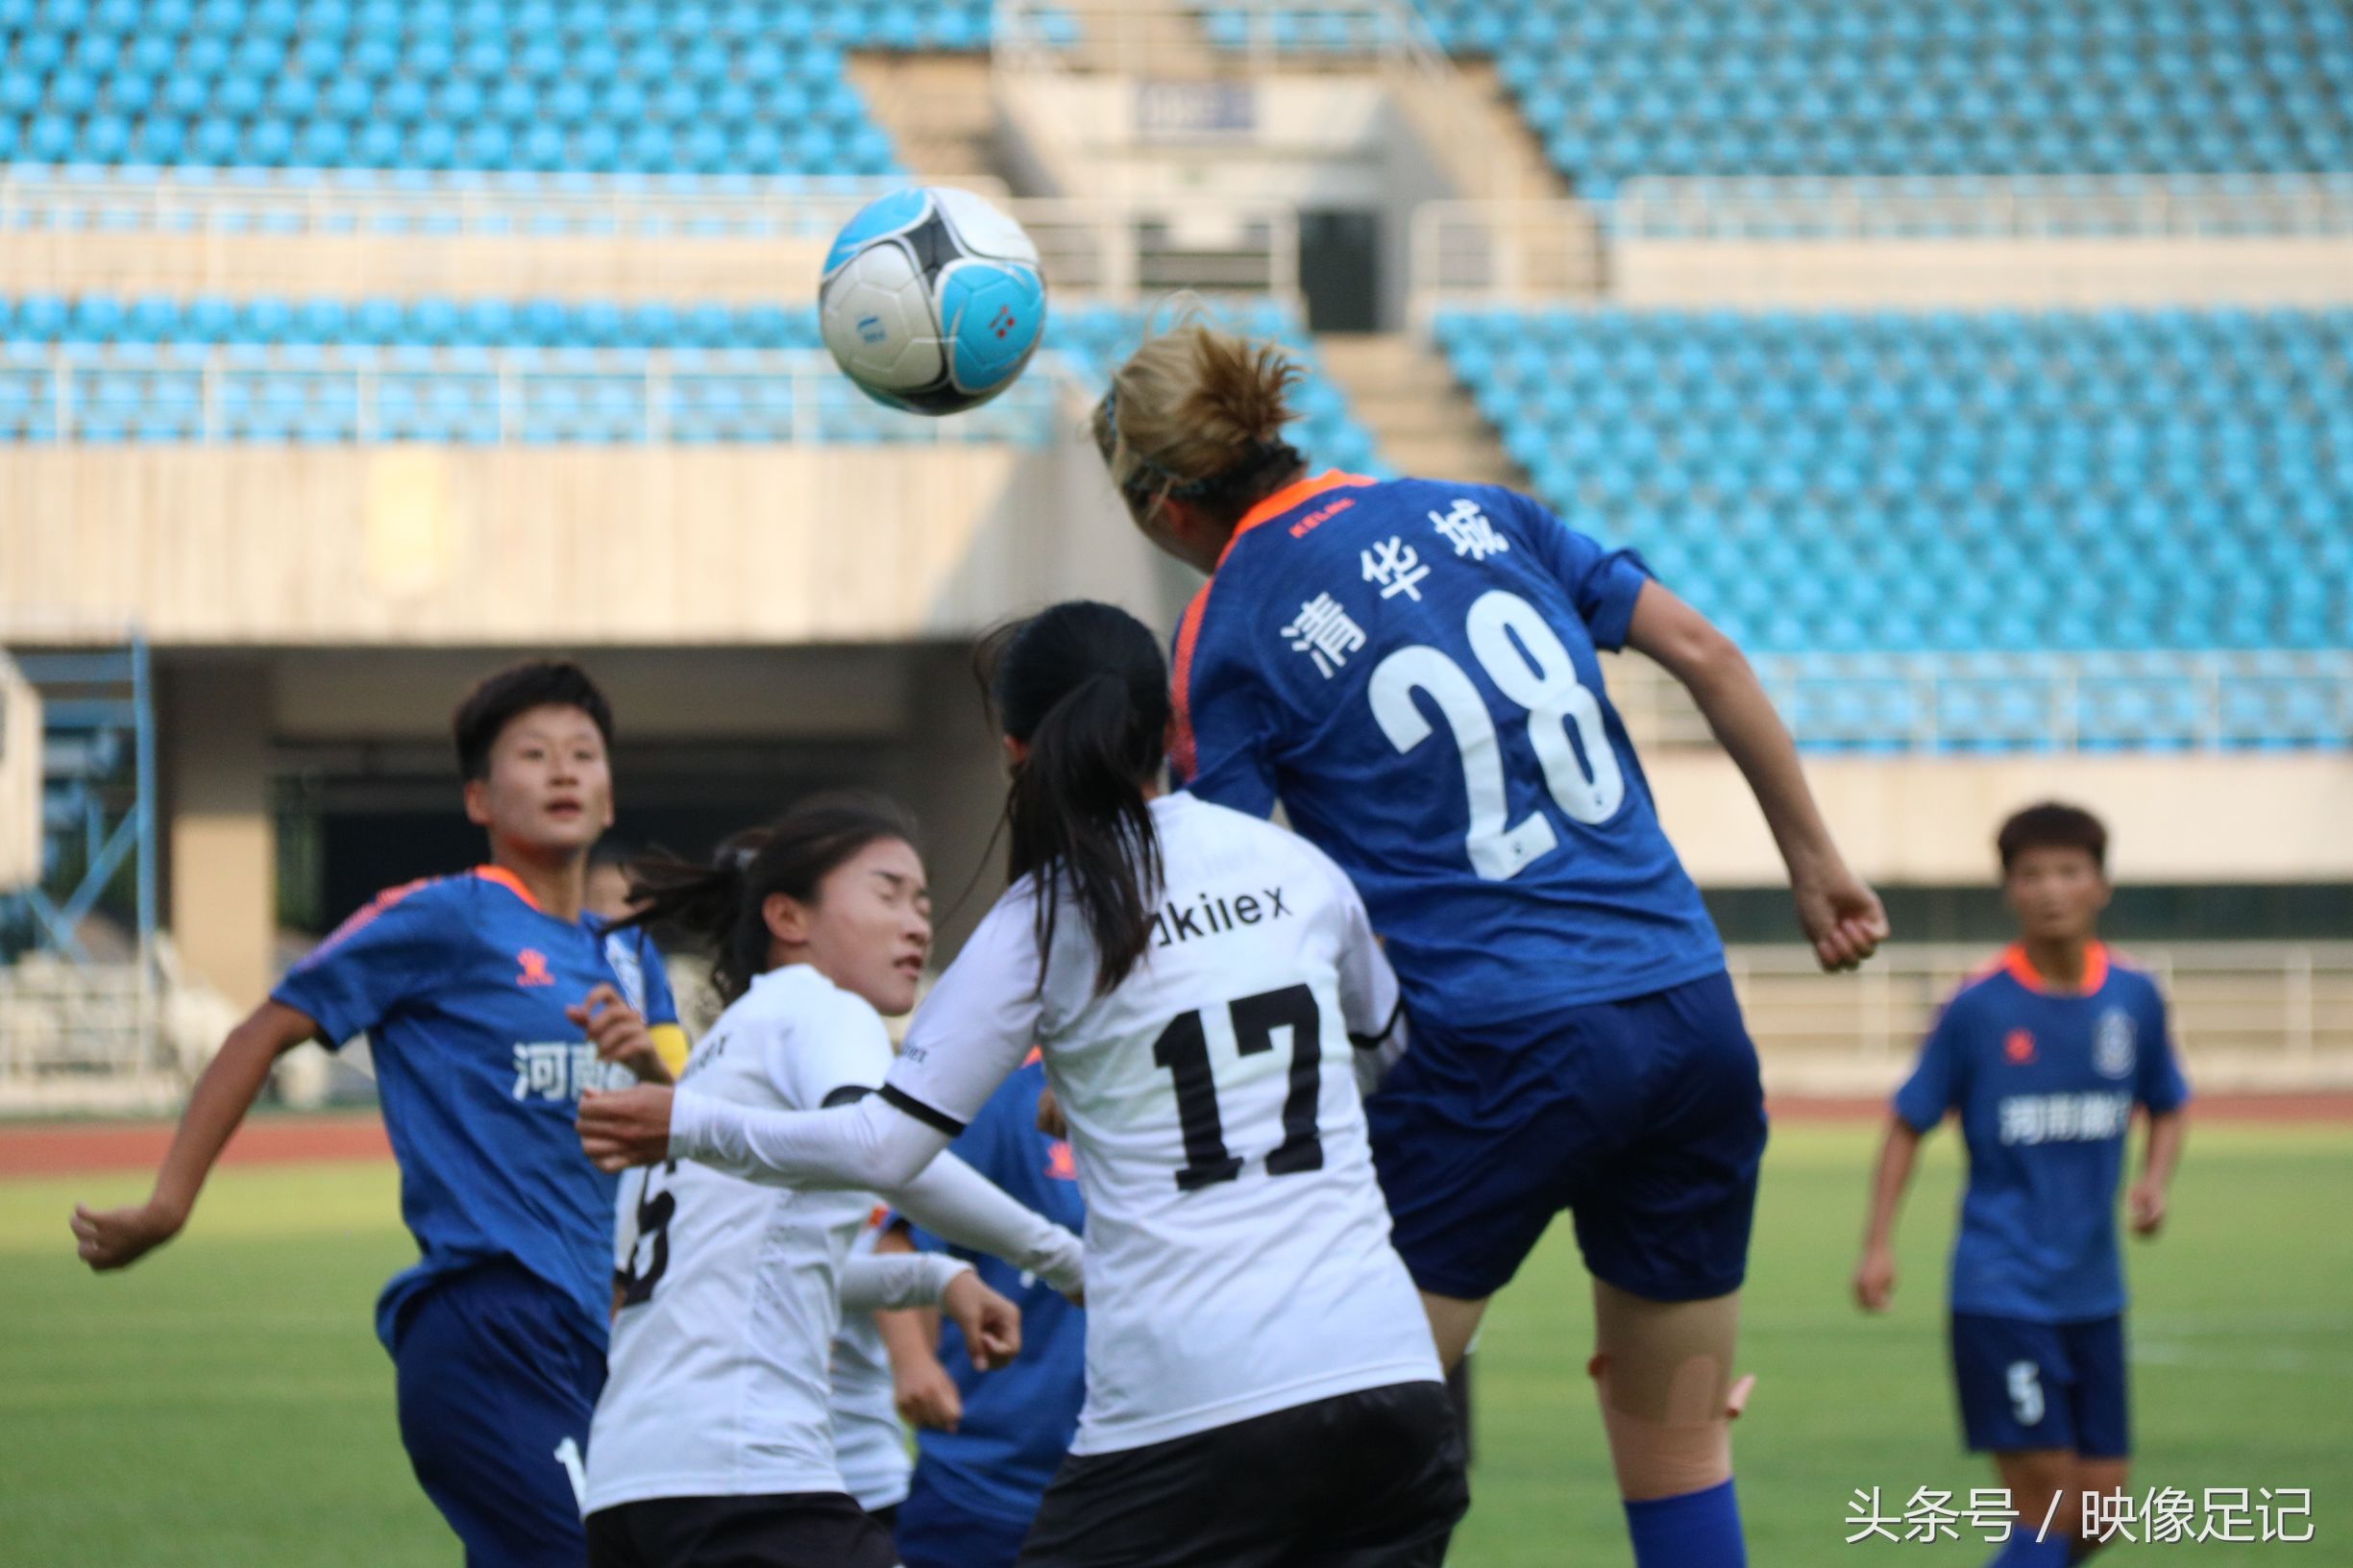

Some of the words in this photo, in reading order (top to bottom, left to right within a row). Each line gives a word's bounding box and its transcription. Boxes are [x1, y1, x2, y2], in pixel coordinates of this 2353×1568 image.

[1367, 589, 1626, 882] 28
[1153, 982, 1325, 1192] 17
[2006, 1360, 2046, 1426] 5
